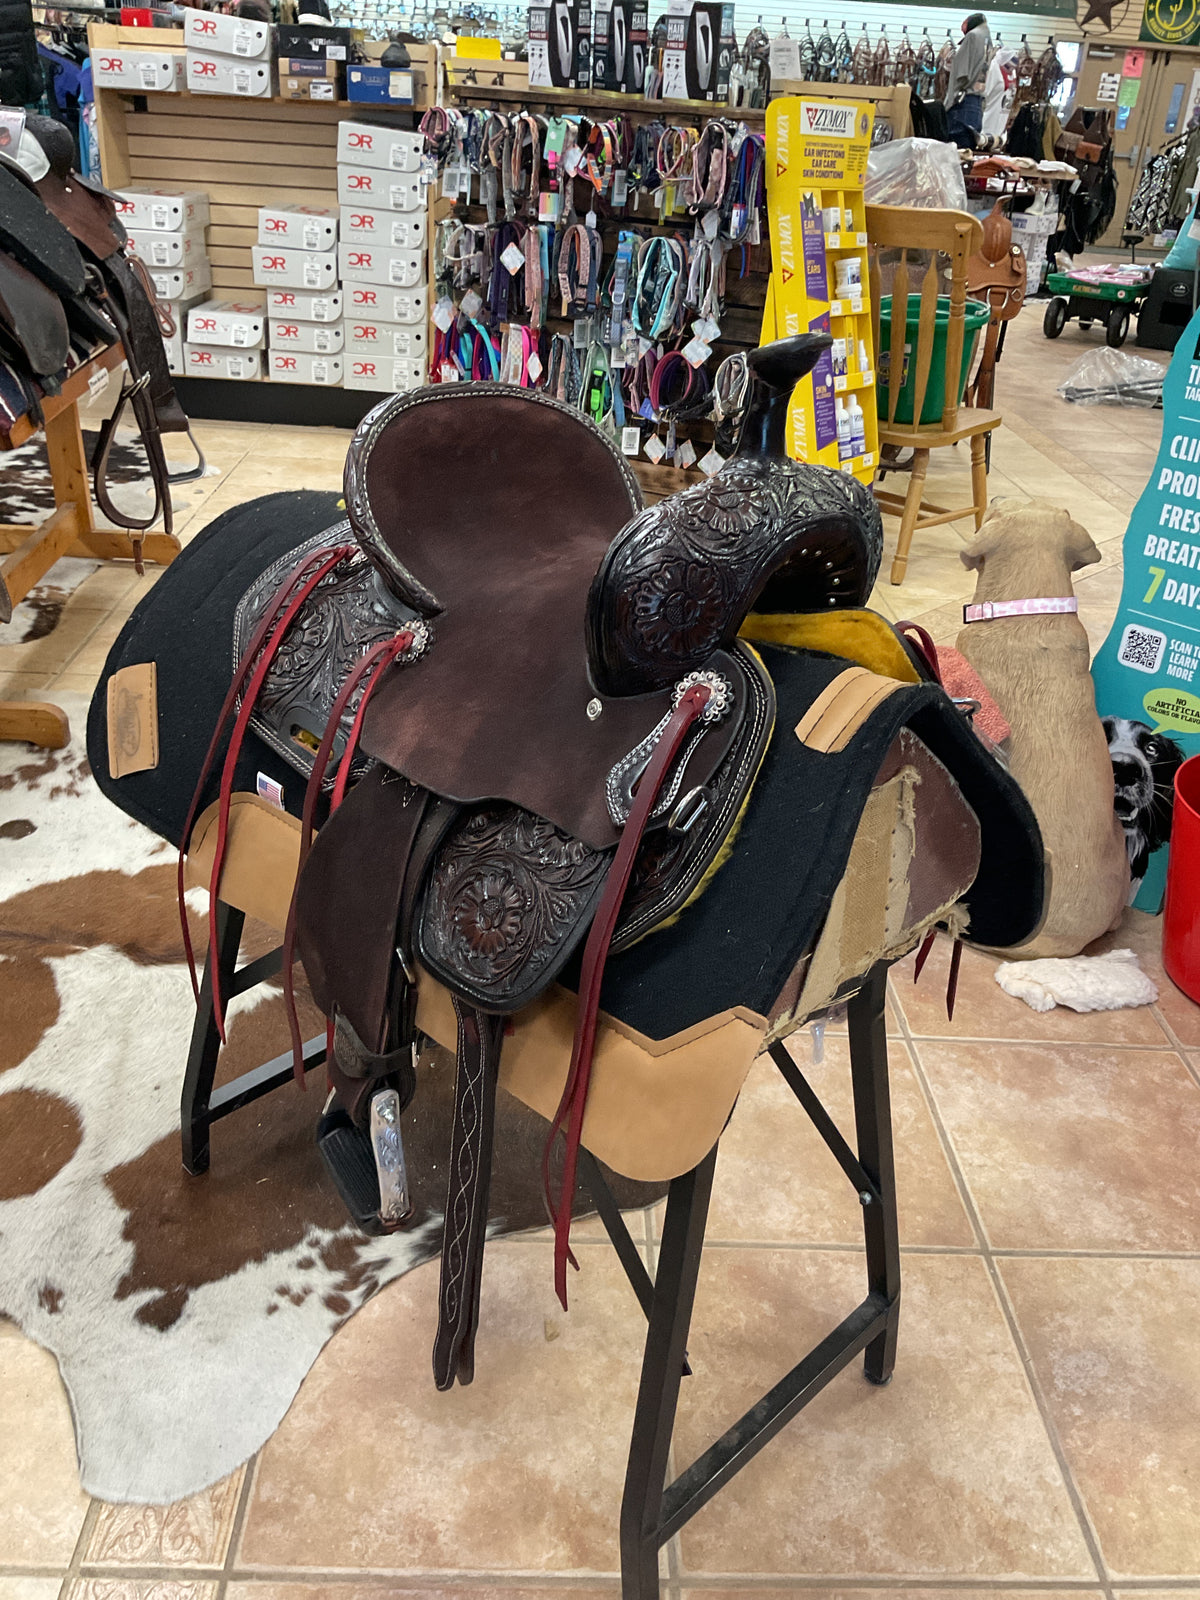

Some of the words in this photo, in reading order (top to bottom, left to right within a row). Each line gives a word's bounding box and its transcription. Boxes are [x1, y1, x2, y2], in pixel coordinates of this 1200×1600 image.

[815, 108, 849, 128] ZYMOX
[776, 112, 790, 164] ZYMOX
[804, 148, 815, 157] EAR
[816, 149, 845, 158] INFECTIONS
[812, 159, 822, 168] EAR
[823, 160, 836, 169] CARE
[803, 169, 814, 178] SKIN
[816, 170, 844, 179] CONDITIONS
[778, 212, 795, 270] ZYMOX
[792, 405, 808, 459] ZYMOX
[1143, 533, 1200, 570] BREAT
[1143, 566, 1166, 604] 7
[1169, 639, 1193, 656] SCAN
[1169, 652, 1199, 670] LEARN
[1166, 664, 1195, 682] MORE
[1147, 705, 1170, 716] COLORS
[1175, 697, 1187, 706] NO
